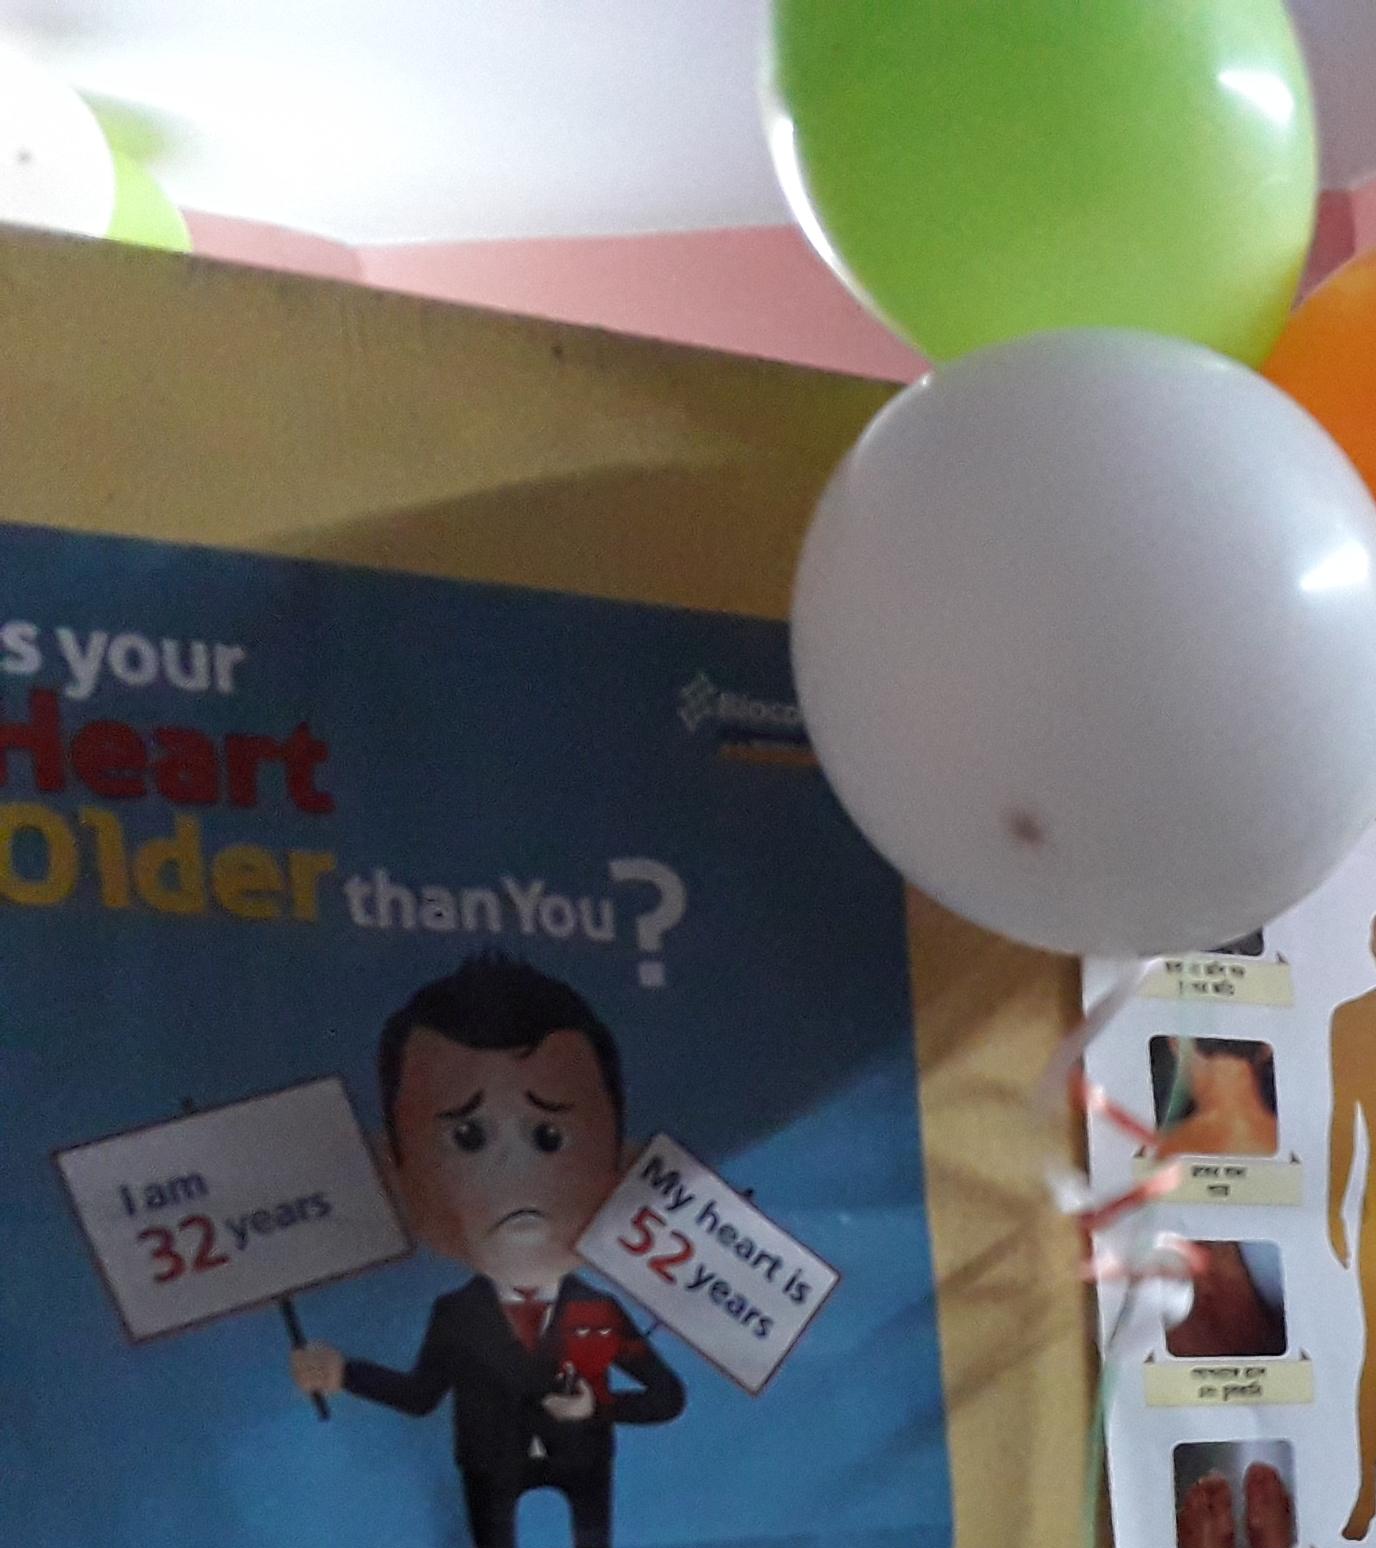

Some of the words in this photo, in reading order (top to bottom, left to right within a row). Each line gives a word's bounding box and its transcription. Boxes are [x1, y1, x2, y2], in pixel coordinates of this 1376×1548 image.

[55, 626, 248, 699] your
[0, 685, 336, 815] Heart
[0, 803, 336, 923] Older
[119, 1183, 136, 1217] I
[143, 1172, 209, 1210] am
[137, 1214, 230, 1284] 32
[225, 1191, 333, 1251] years
[640, 1155, 695, 1211] My
[696, 1199, 783, 1282] heart
[782, 1268, 812, 1304] is
[617, 1206, 696, 1286] 52
[685, 1263, 774, 1340] years
